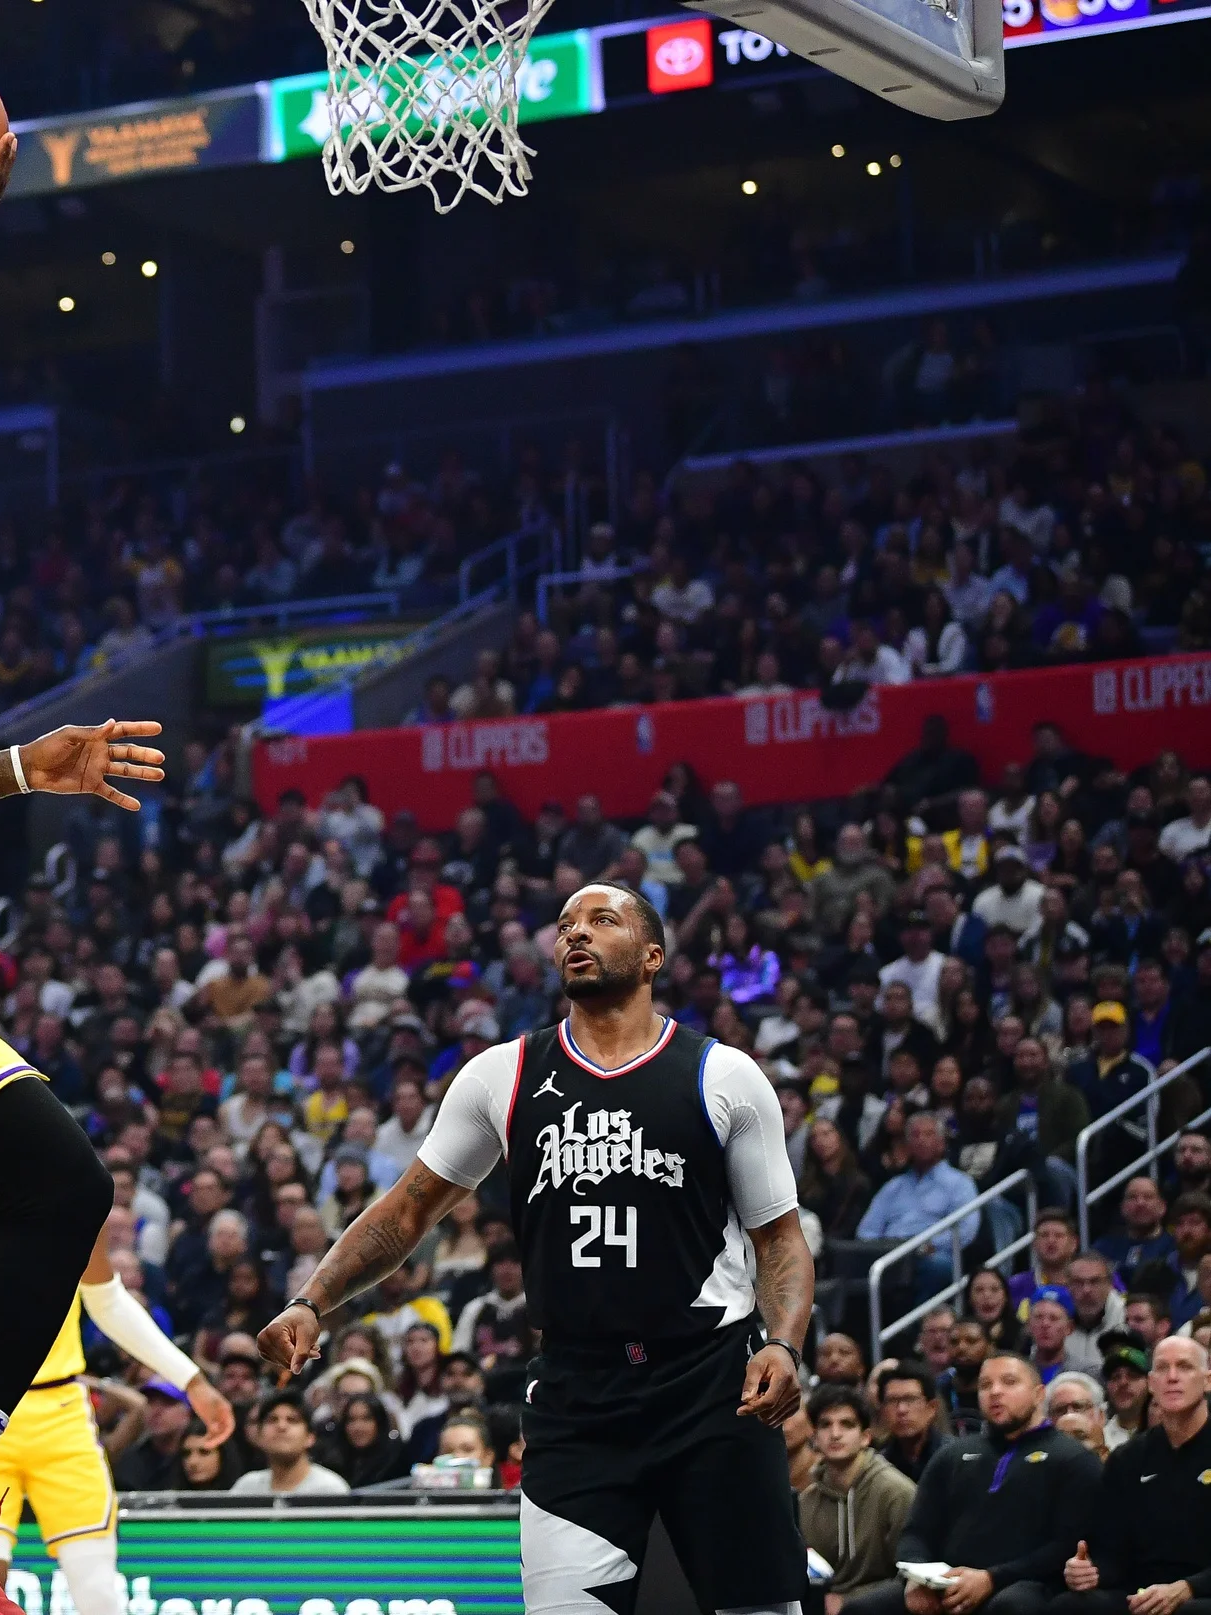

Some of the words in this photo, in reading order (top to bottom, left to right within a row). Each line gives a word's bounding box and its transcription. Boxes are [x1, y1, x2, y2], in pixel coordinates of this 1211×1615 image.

[447, 722, 549, 769] CLIPPERS
[560, 1101, 632, 1144] Los
[527, 1124, 686, 1204] Angeles
[569, 1205, 637, 1268] 24
